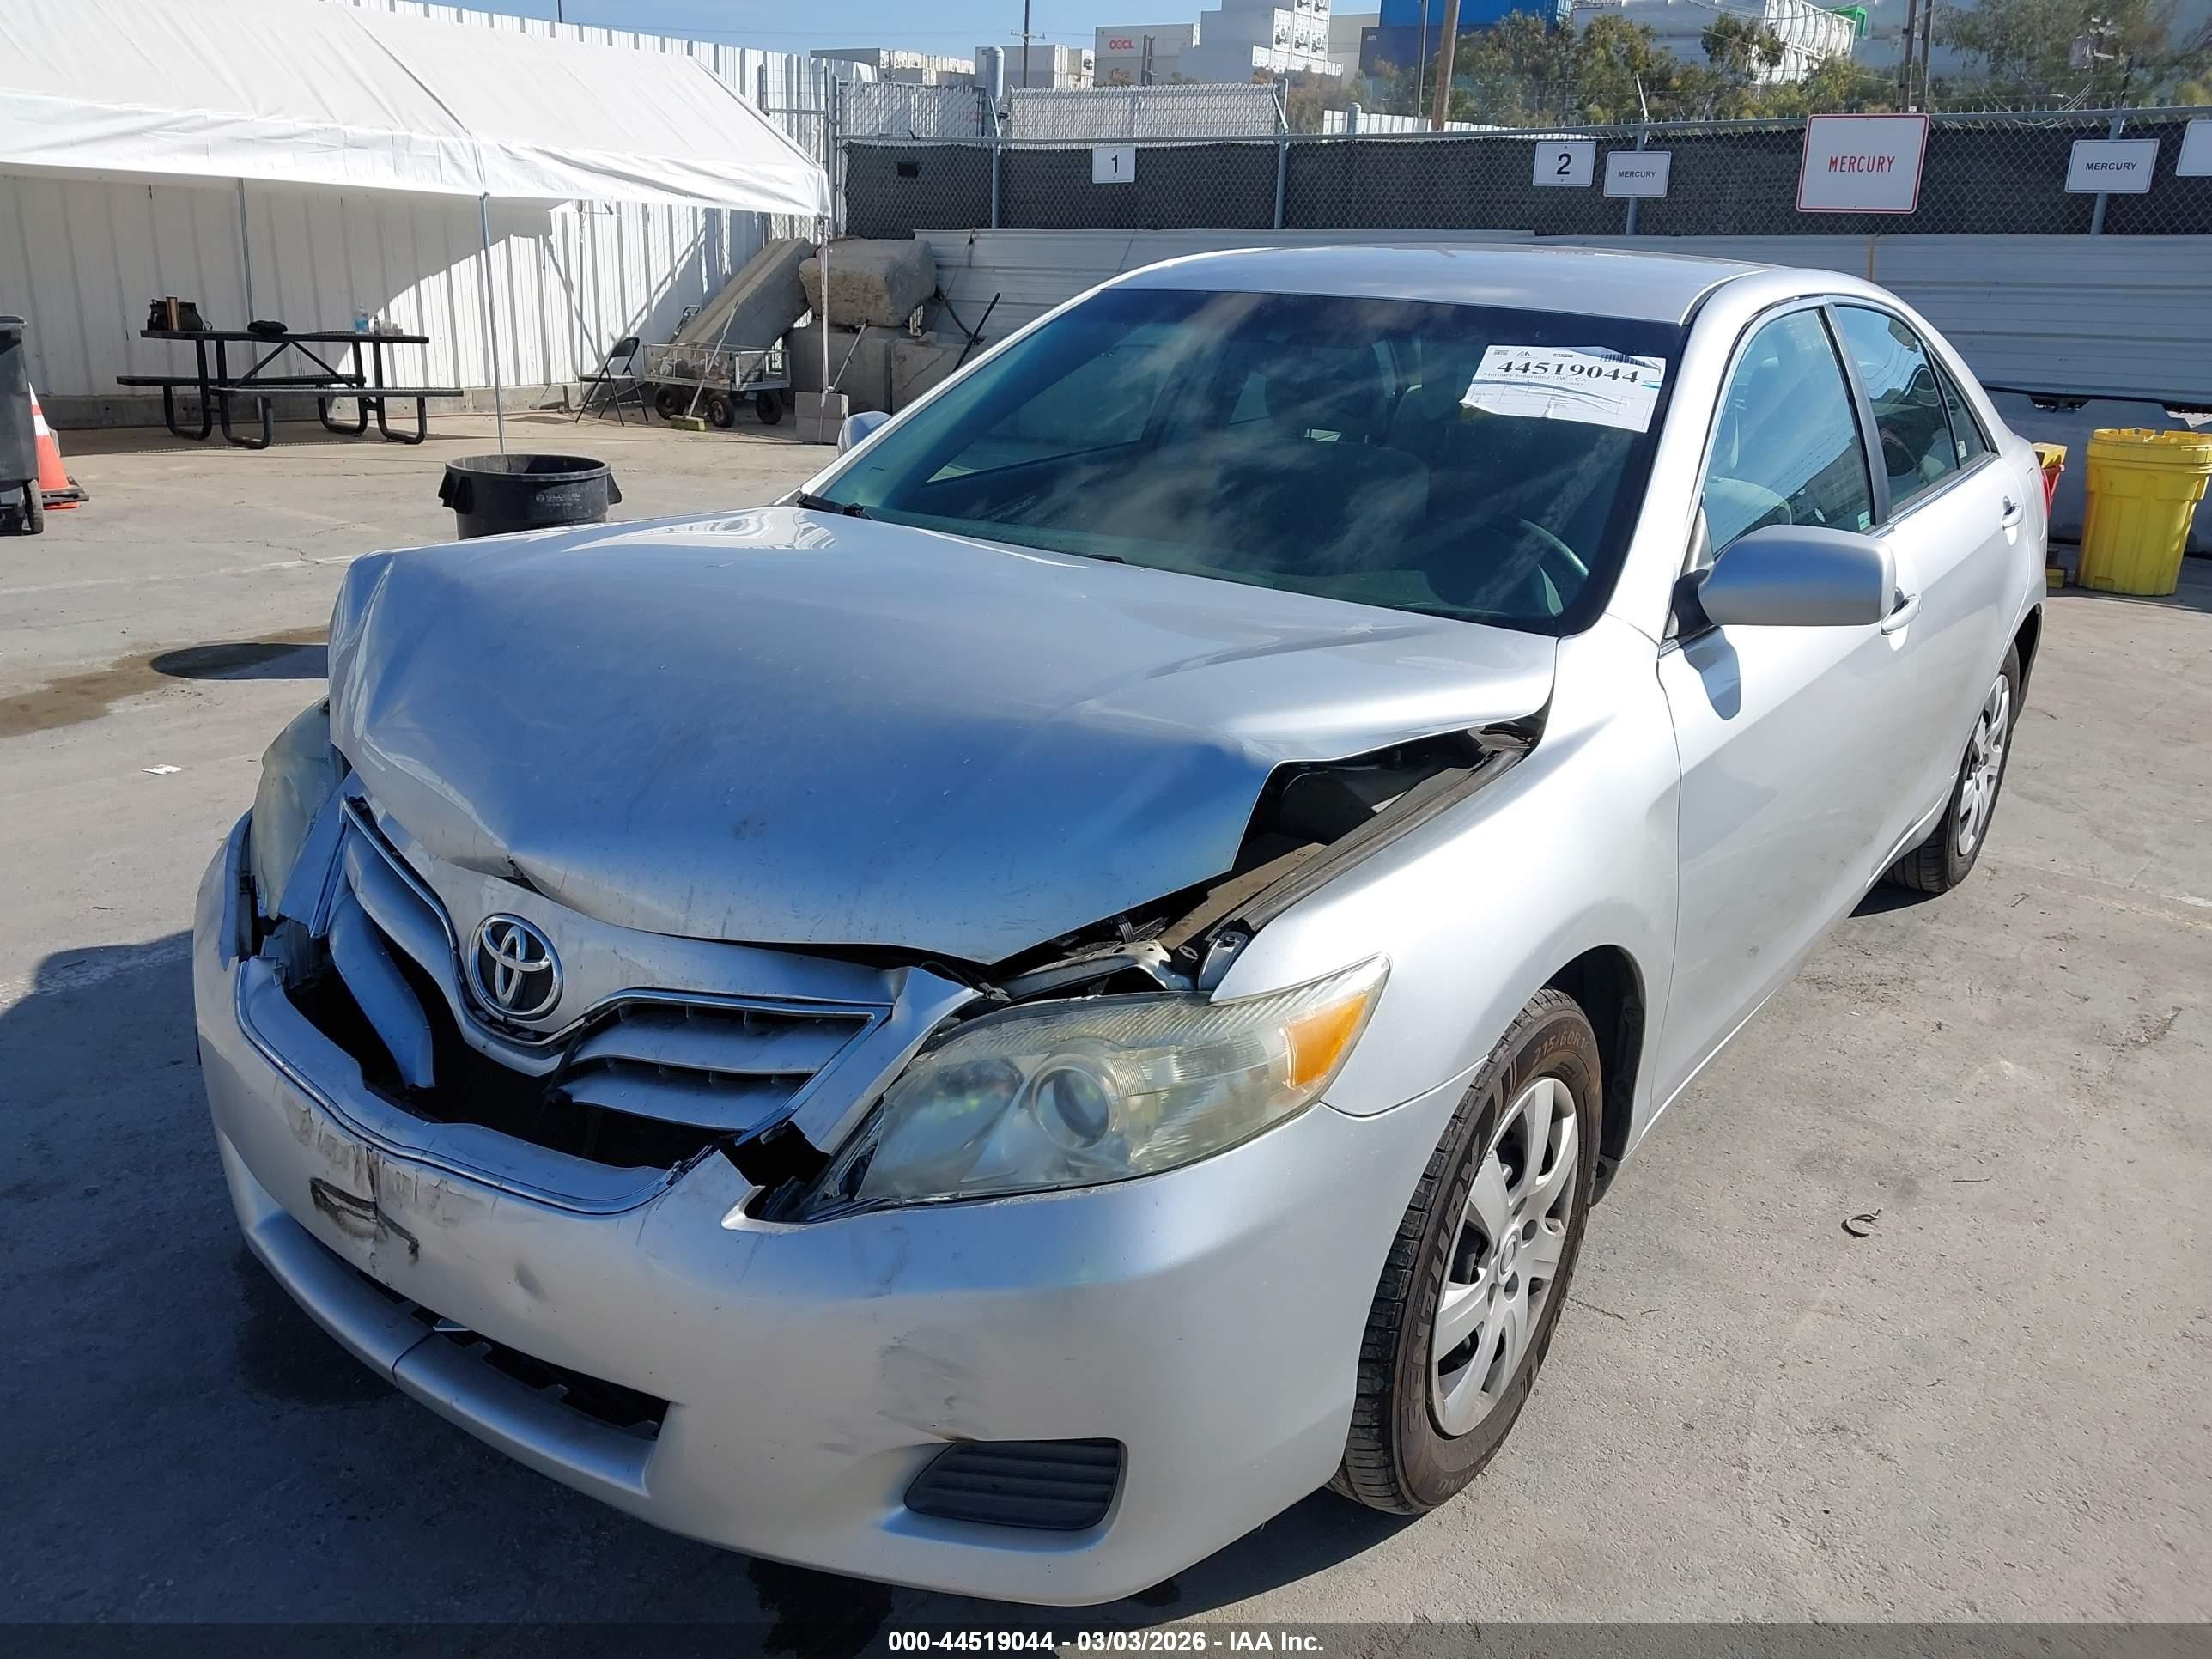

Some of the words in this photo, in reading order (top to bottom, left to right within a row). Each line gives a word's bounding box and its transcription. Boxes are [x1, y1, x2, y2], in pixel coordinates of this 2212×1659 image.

[1111, 155, 1118, 173] 1
[1556, 152, 1571, 175] 2
[1828, 155, 1895, 173] MERCURY
[2085, 161, 2137, 171] MERCURY
[1618, 170, 1656, 179] MERCURY
[1497, 361, 1639, 383] 44519044
